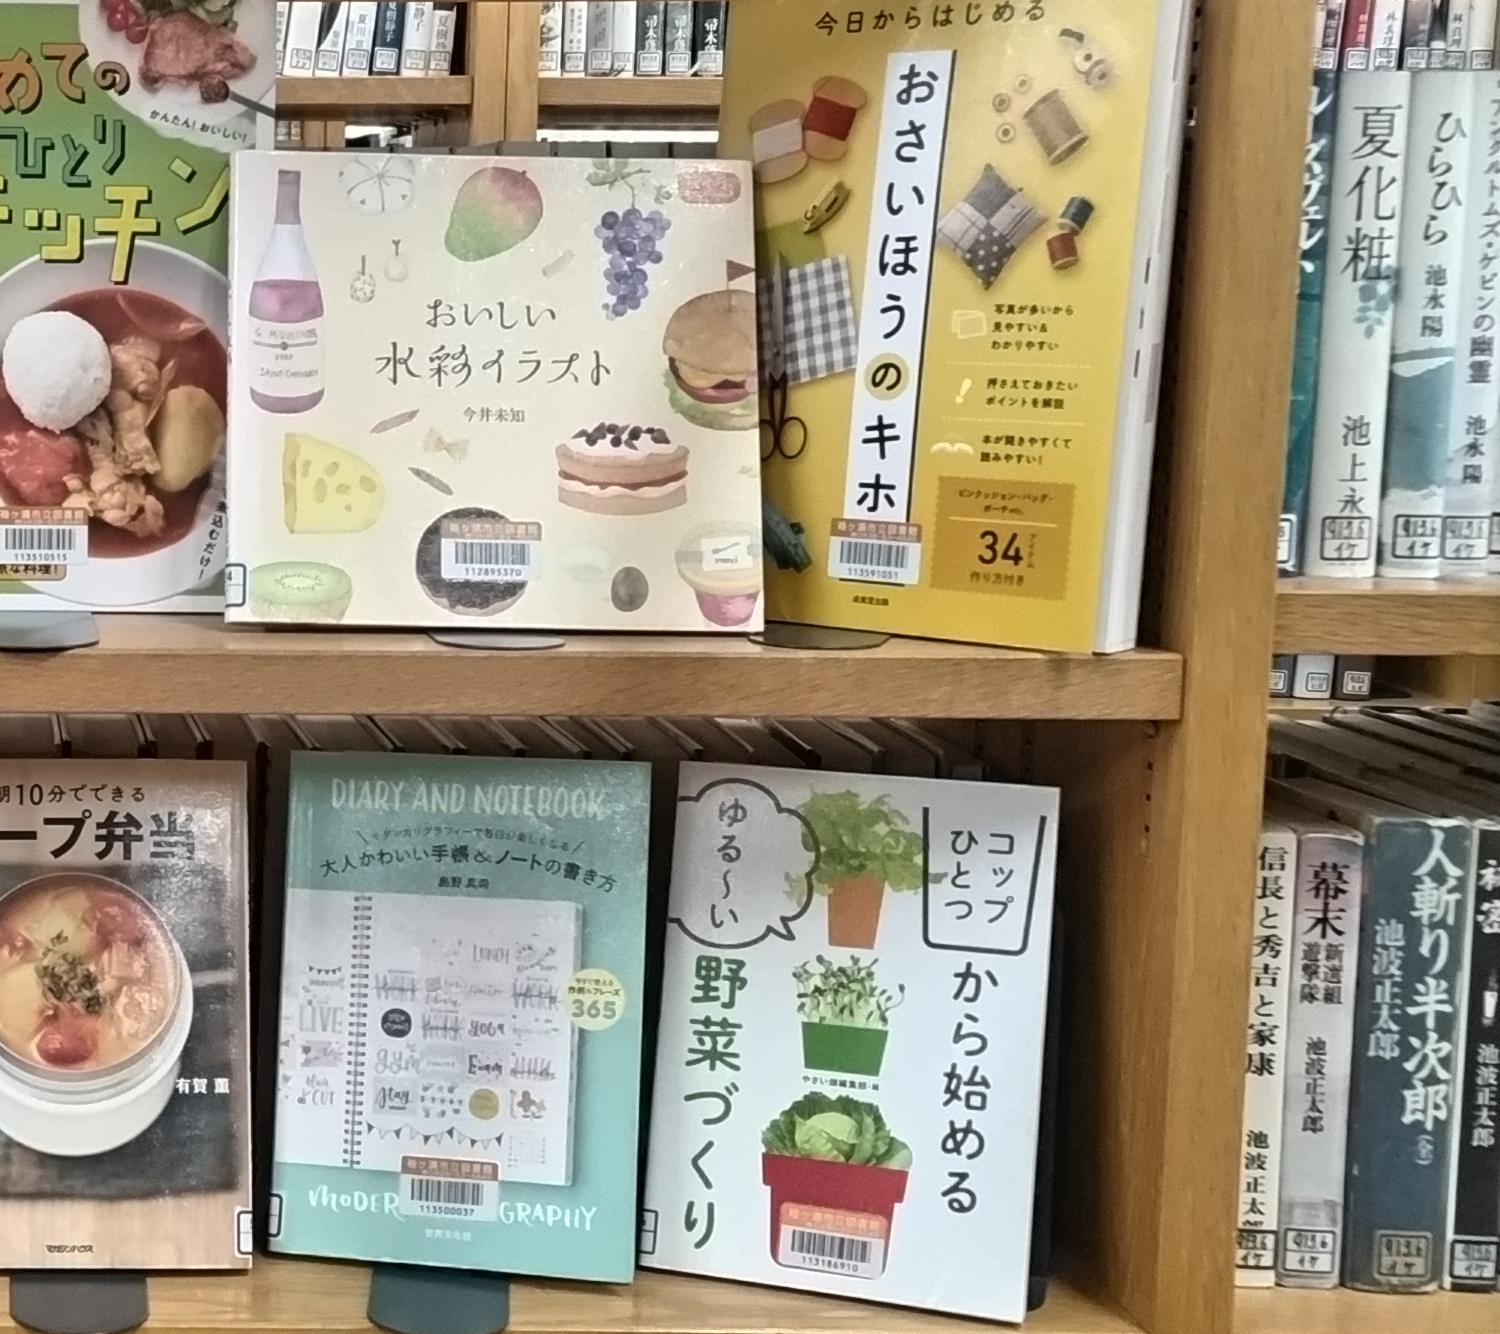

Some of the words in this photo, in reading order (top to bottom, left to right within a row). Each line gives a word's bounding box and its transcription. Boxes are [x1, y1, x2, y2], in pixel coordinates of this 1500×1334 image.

[1340, 103, 1404, 284] 夏化粧
[1420, 111, 1469, 246] ひらひら
[425, 298, 557, 330] おいしい
[1419, 263, 1450, 338] 池永陽
[374, 341, 613, 389] 水彩イラスト
[462, 405, 526, 424] 今井未知
[13, 552, 69, 563] 113510515
[977, 529, 1024, 568] 34
[331, 777, 405, 811] DIARY
[411, 784, 467, 815] AND
[473, 783, 610, 821] NOTEBOOK
[944, 829, 979, 921] ひとつ
[984, 831, 1015, 924] コップ
[1303, 861, 1352, 941] 幕末
[1245, 845, 1288, 1078] 信長と秀吉と家康
[1367, 917, 1408, 1062] 池波正太郎
[1401, 828, 1465, 1132] 人斬り半次郎
[571, 999, 617, 1019] 365
[175, 1077, 208, 1095] 有賀
[683, 954, 749, 1249] 野菜づくり
[940, 961, 1000, 1214] から始める
[1302, 1035, 1328, 1135] 池波正太郎
